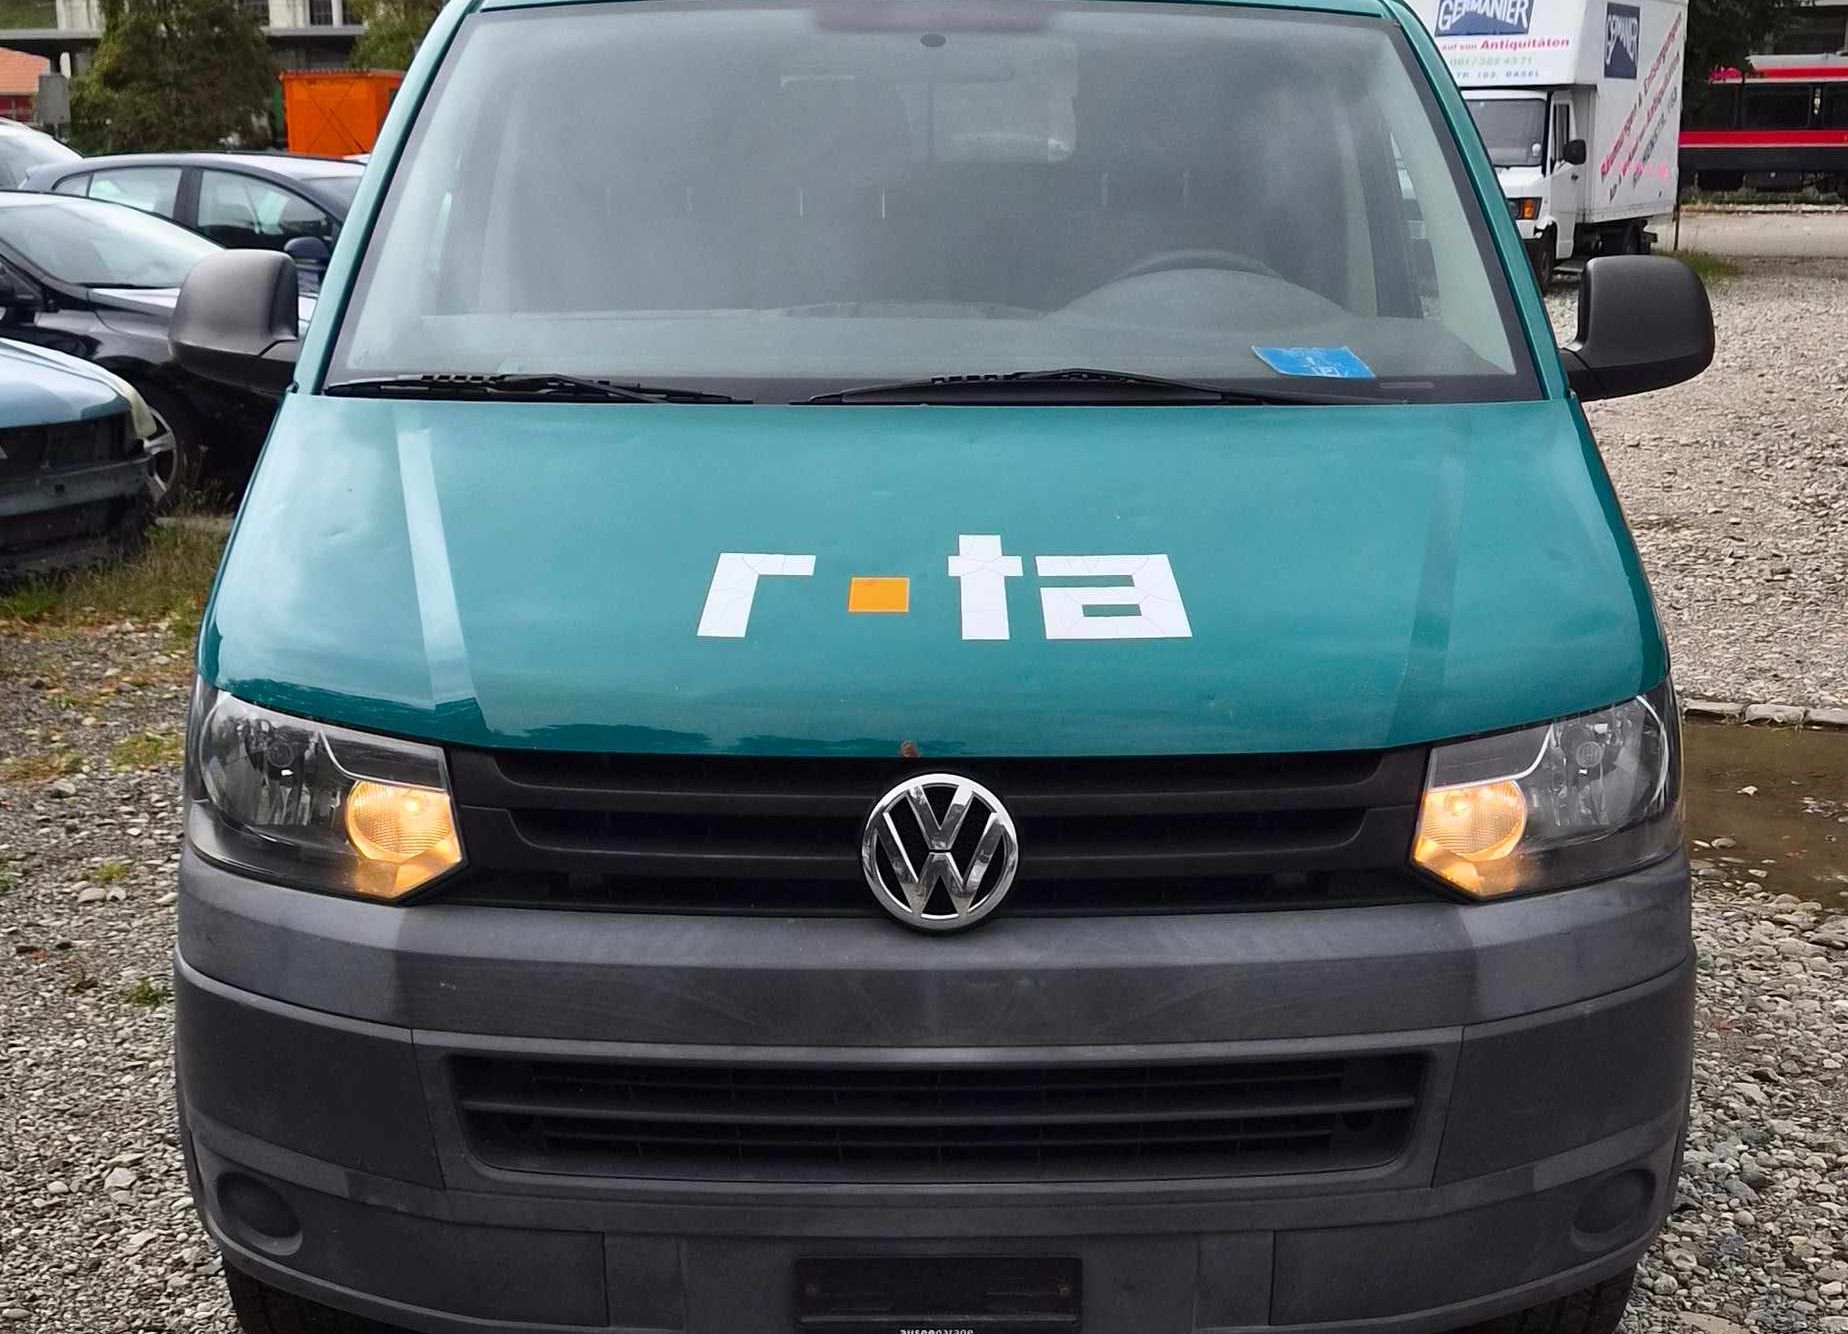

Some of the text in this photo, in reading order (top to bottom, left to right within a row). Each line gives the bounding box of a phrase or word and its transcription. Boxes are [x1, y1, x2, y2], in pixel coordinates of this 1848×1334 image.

[1441, 38, 1570, 52] auf von Antiquitäten
[1505, 70, 1540, 78] BASEL
